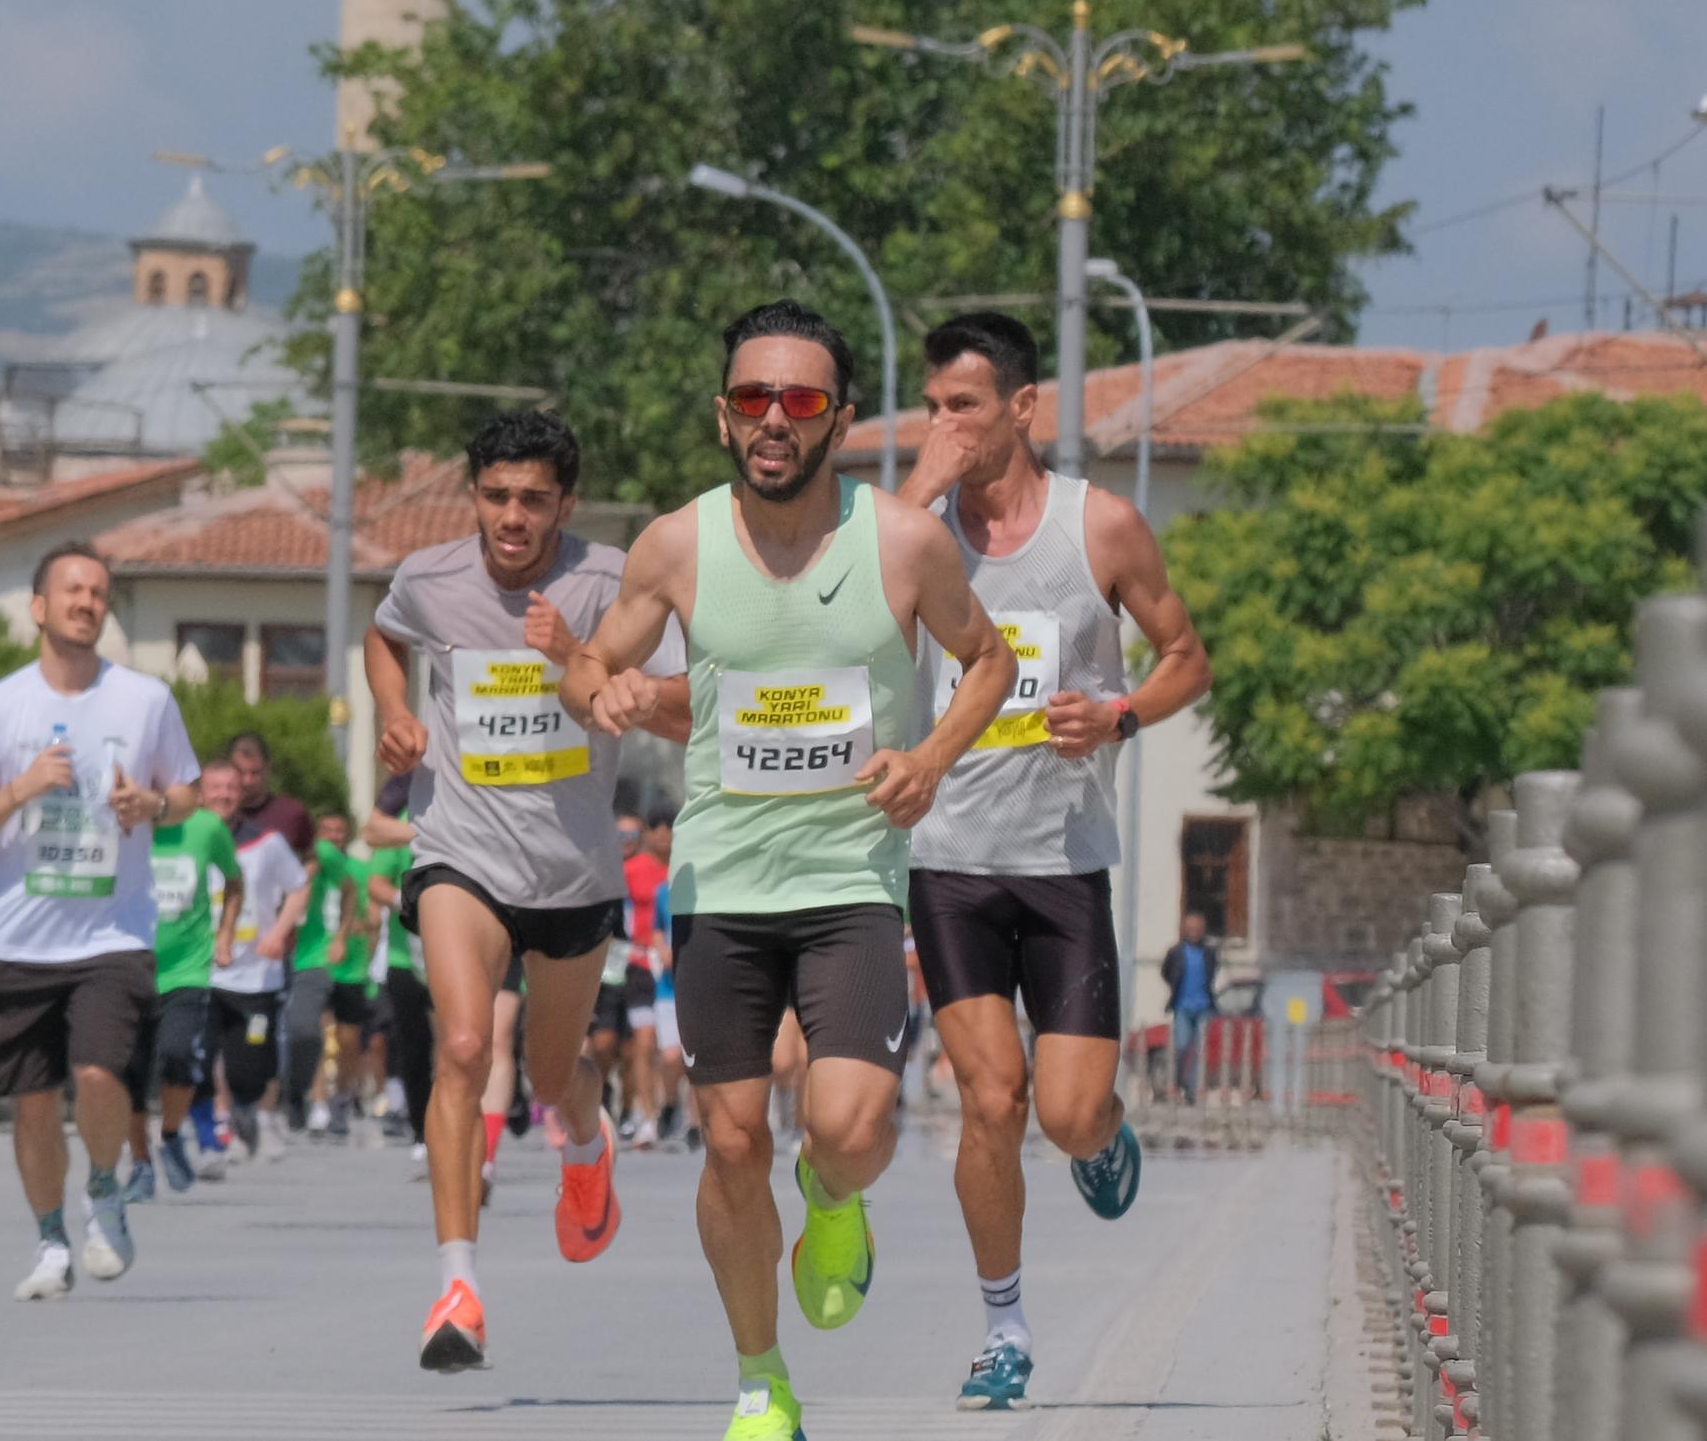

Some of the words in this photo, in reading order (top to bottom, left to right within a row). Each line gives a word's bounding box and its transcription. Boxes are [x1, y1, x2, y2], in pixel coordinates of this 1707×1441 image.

[759, 687, 821, 701] KONYA
[769, 701, 812, 712] YARI
[478, 712, 561, 736] 42151
[741, 709, 844, 724] MARATONU
[737, 741, 853, 771] 42264
